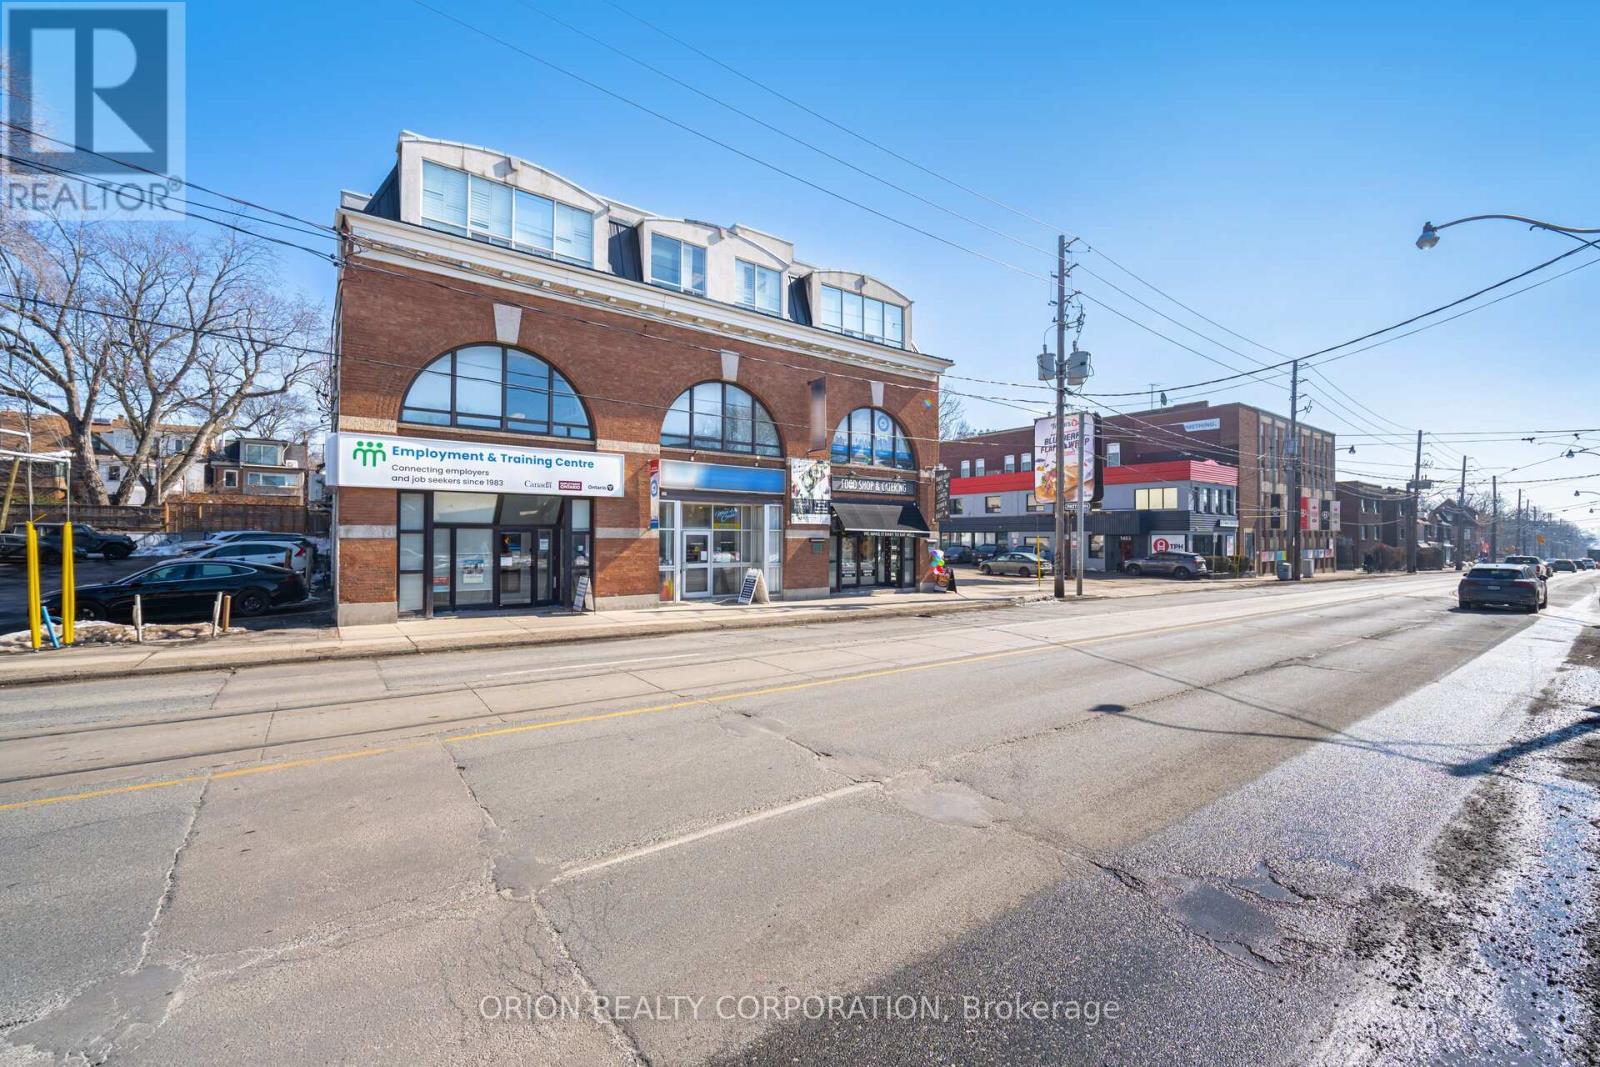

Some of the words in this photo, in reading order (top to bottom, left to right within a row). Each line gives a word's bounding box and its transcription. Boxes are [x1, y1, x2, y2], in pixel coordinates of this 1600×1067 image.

[392, 446, 484, 461] Employment
[487, 453, 497, 462] &
[500, 453, 552, 468] Training
[555, 458, 594, 468] Centre
[391, 464, 443, 475] Connecting
[445, 469, 489, 477] employers
[411, 475, 426, 484] job
[462, 478, 485, 486] since
[841, 479, 857, 489] FOOD
[858, 480, 874, 490] SHOP
[875, 481, 880, 491] &
[881, 481, 907, 492] CATERING
